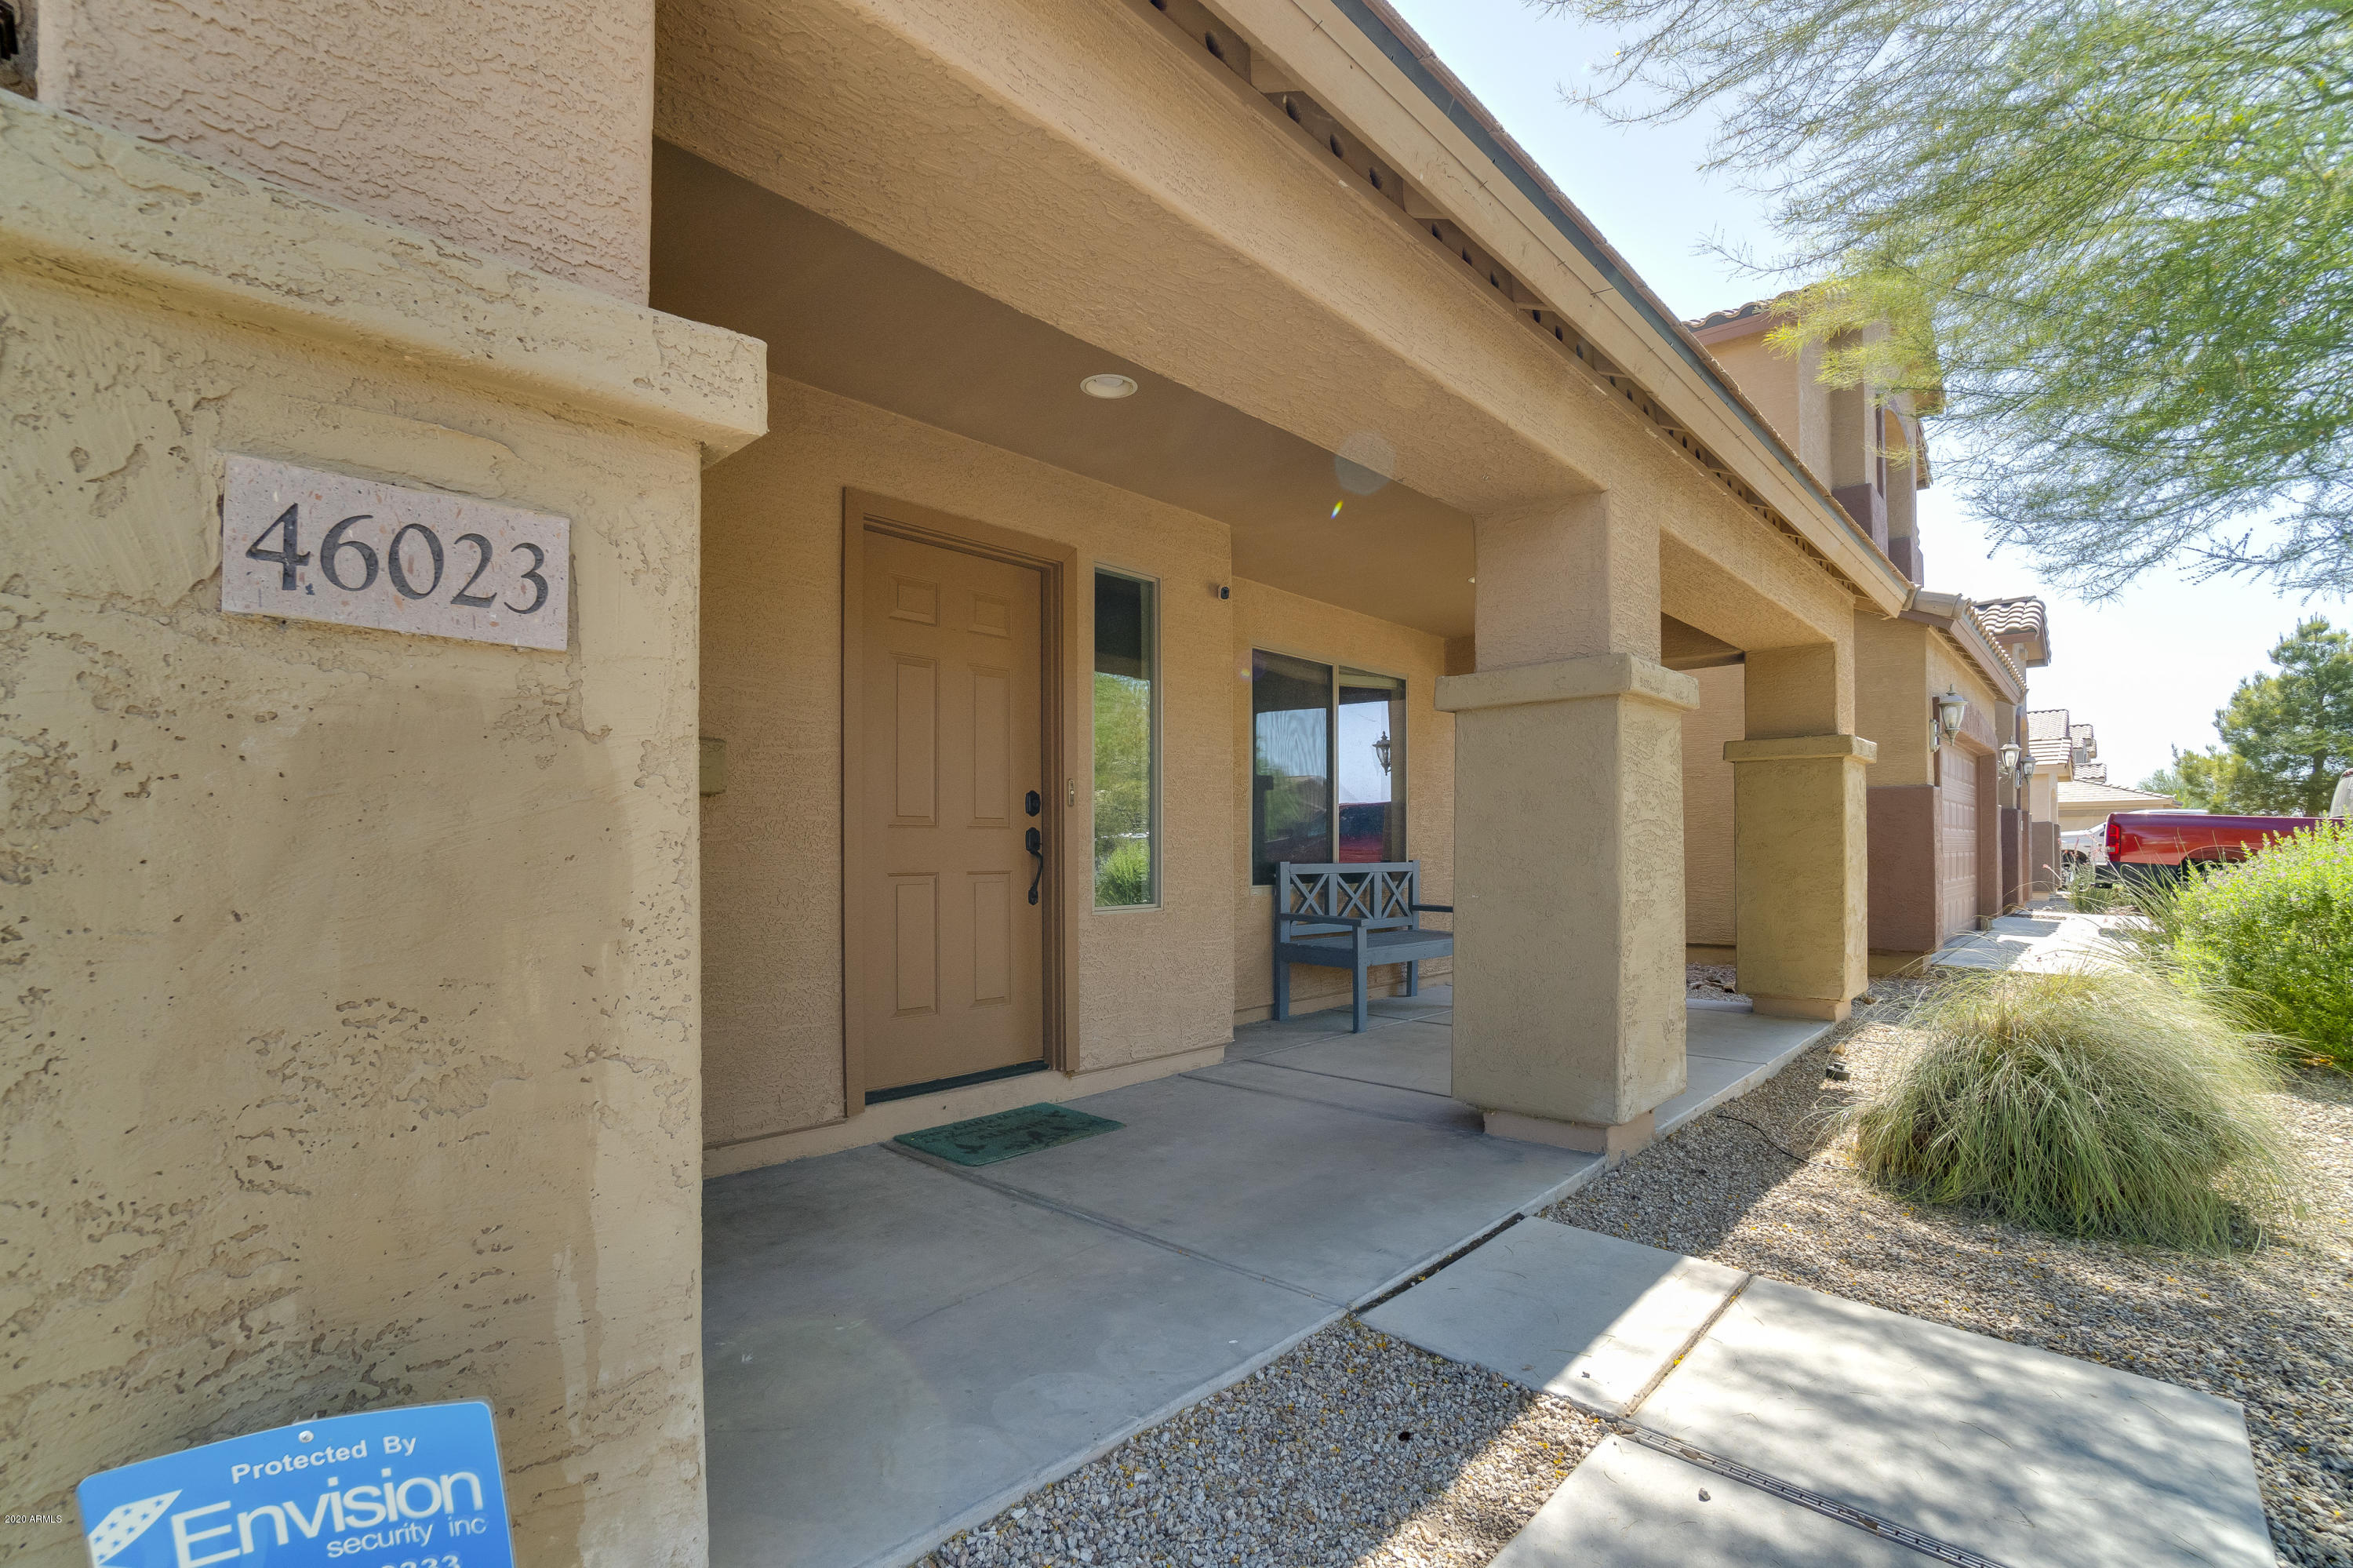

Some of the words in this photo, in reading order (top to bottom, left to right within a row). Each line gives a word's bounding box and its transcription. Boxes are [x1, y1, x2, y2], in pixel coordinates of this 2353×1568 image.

[245, 502, 549, 615] 46023
[231, 1439, 368, 1484] Protected
[382, 1435, 416, 1457] By
[170, 1468, 484, 1568] Envision
[326, 1522, 433, 1558] security
[448, 1516, 487, 1537] inc
